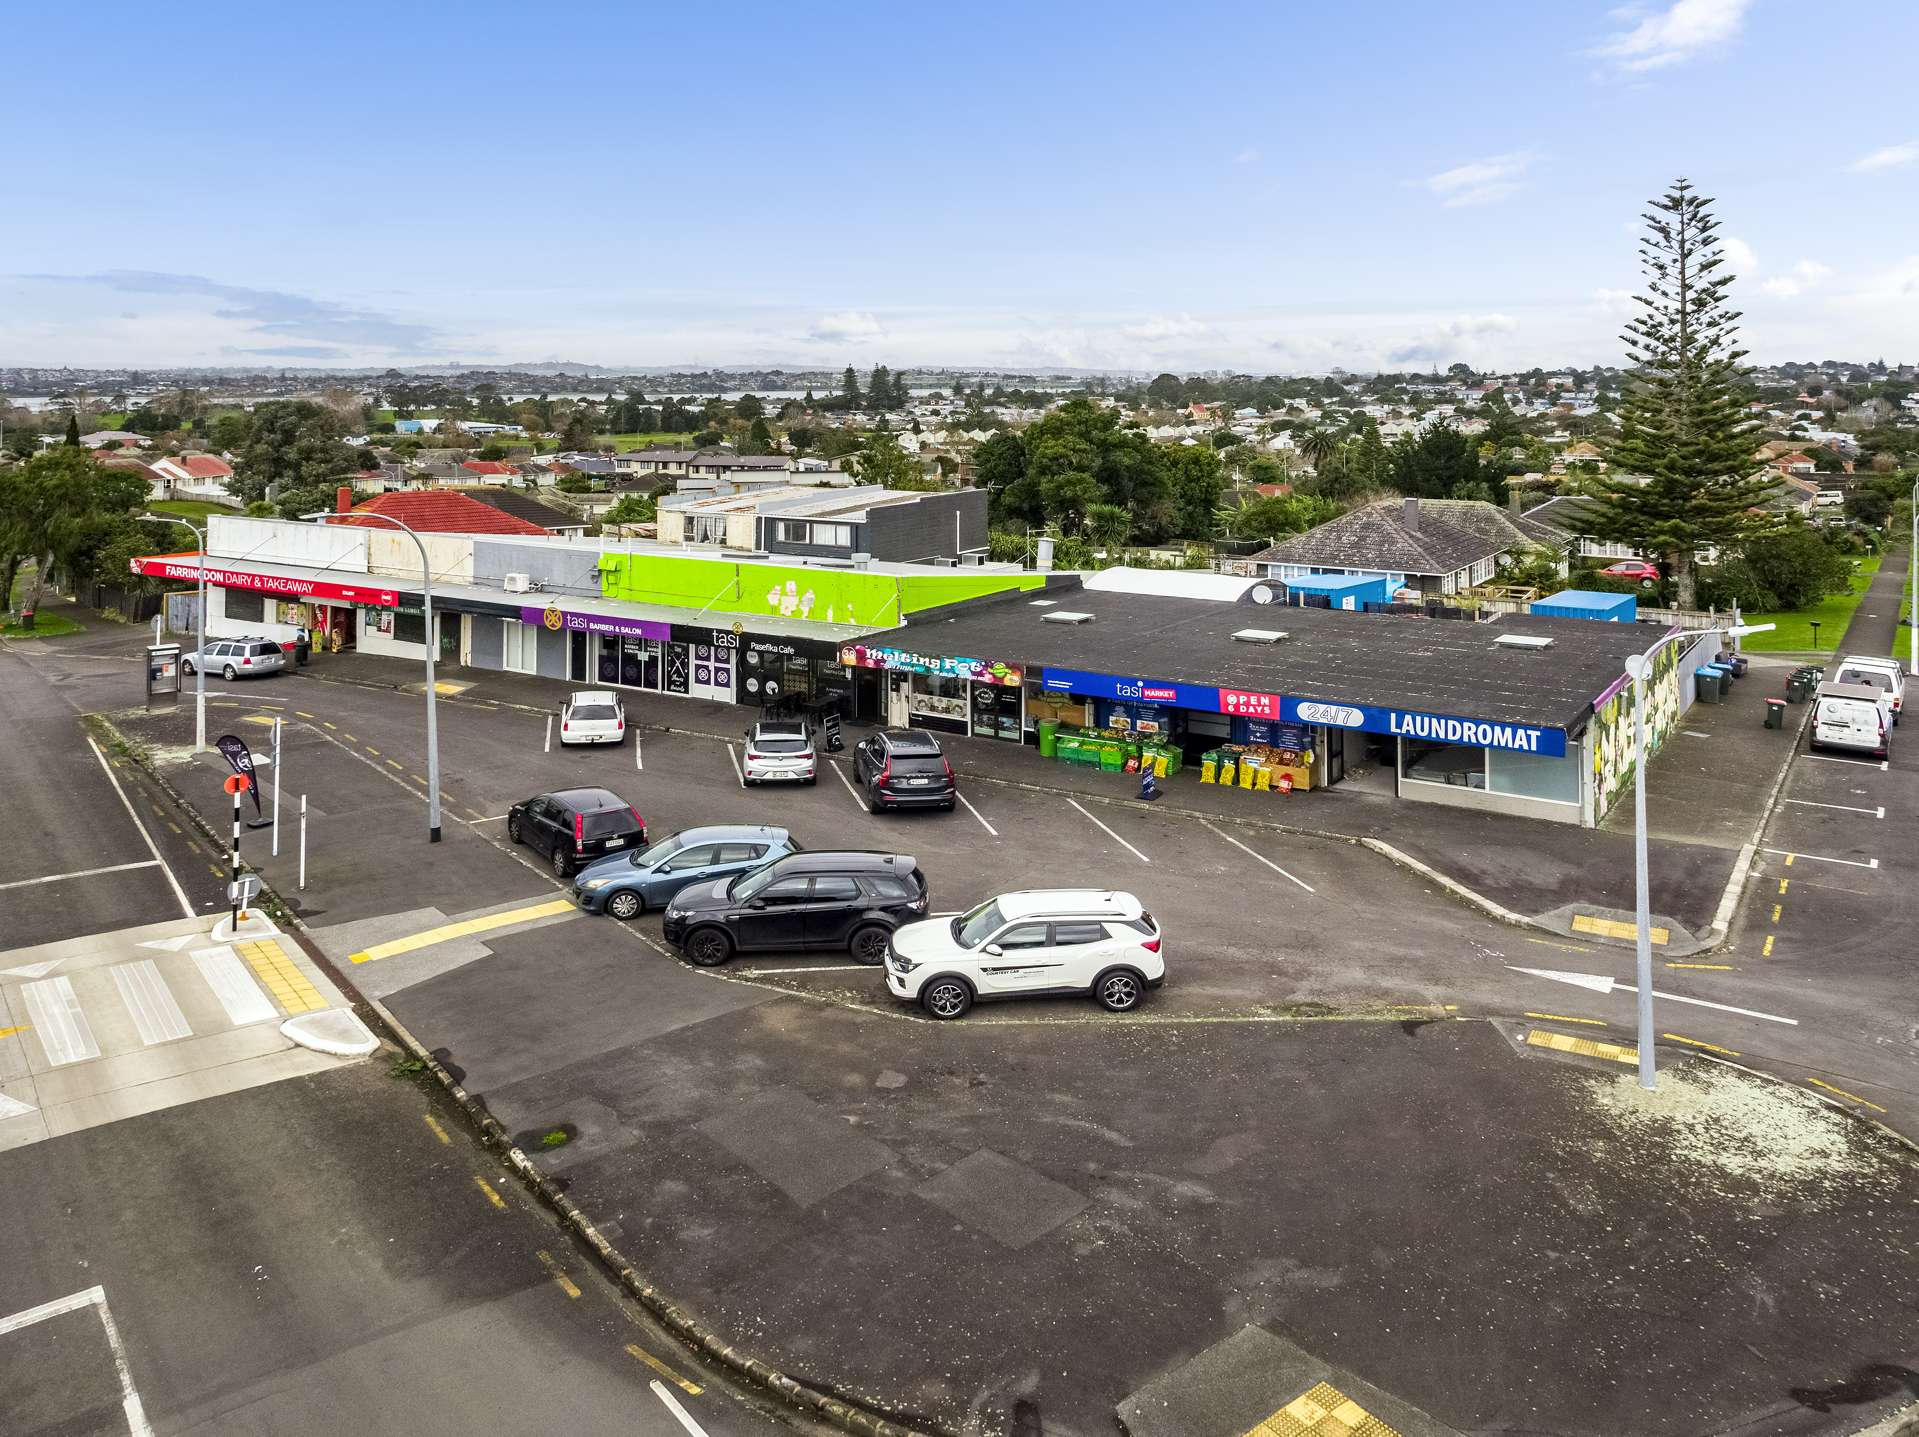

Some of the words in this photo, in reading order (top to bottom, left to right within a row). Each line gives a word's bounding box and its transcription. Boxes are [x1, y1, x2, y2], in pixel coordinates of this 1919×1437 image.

[225, 573, 252, 586] DAIRY
[254, 577, 261, 587] &
[263, 577, 314, 594] TAKEAWAY
[567, 613, 588, 629] tasi
[590, 623, 614, 632] BARBER
[621, 626, 641, 635] SALON
[713, 629, 739, 648] tasi
[751, 642, 778, 654] Pasefika
[779, 645, 795, 655] Cafe
[943, 658, 983, 672] Pot
[1116, 680, 1143, 698] tasi
[1144, 689, 1174, 698] MARKET
[1227, 694, 1270, 705] OPEN
[1240, 706, 1271, 714] DAYS
[1307, 703, 1353, 725] 24/7
[1390, 713, 1540, 752] LAUNDROMAT
